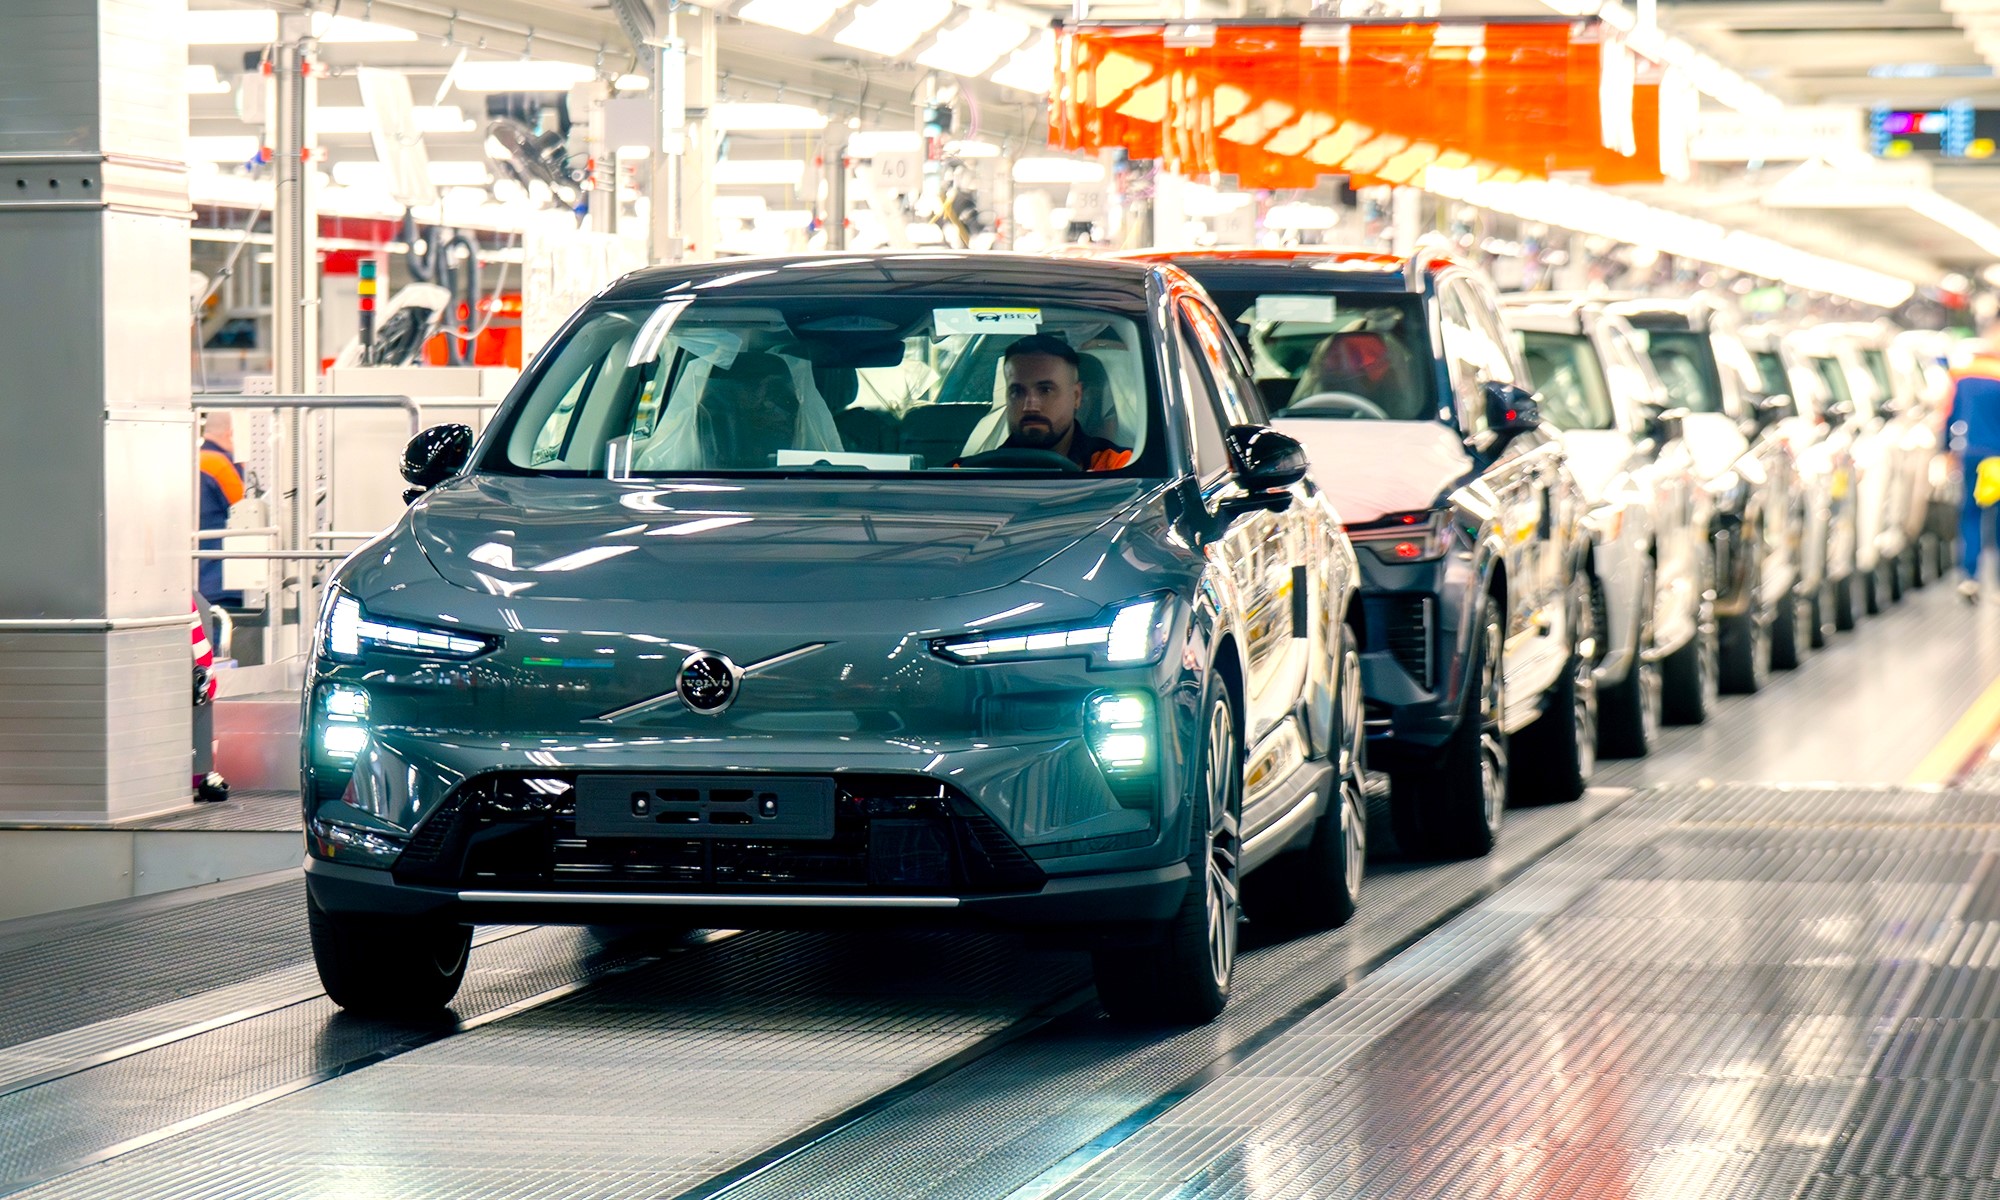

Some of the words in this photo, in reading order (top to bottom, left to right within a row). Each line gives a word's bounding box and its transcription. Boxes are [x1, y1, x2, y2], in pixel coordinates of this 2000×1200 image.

[882, 160, 906, 178] 40
[1079, 192, 1099, 208] 38
[685, 679, 730, 687] VOLVO
